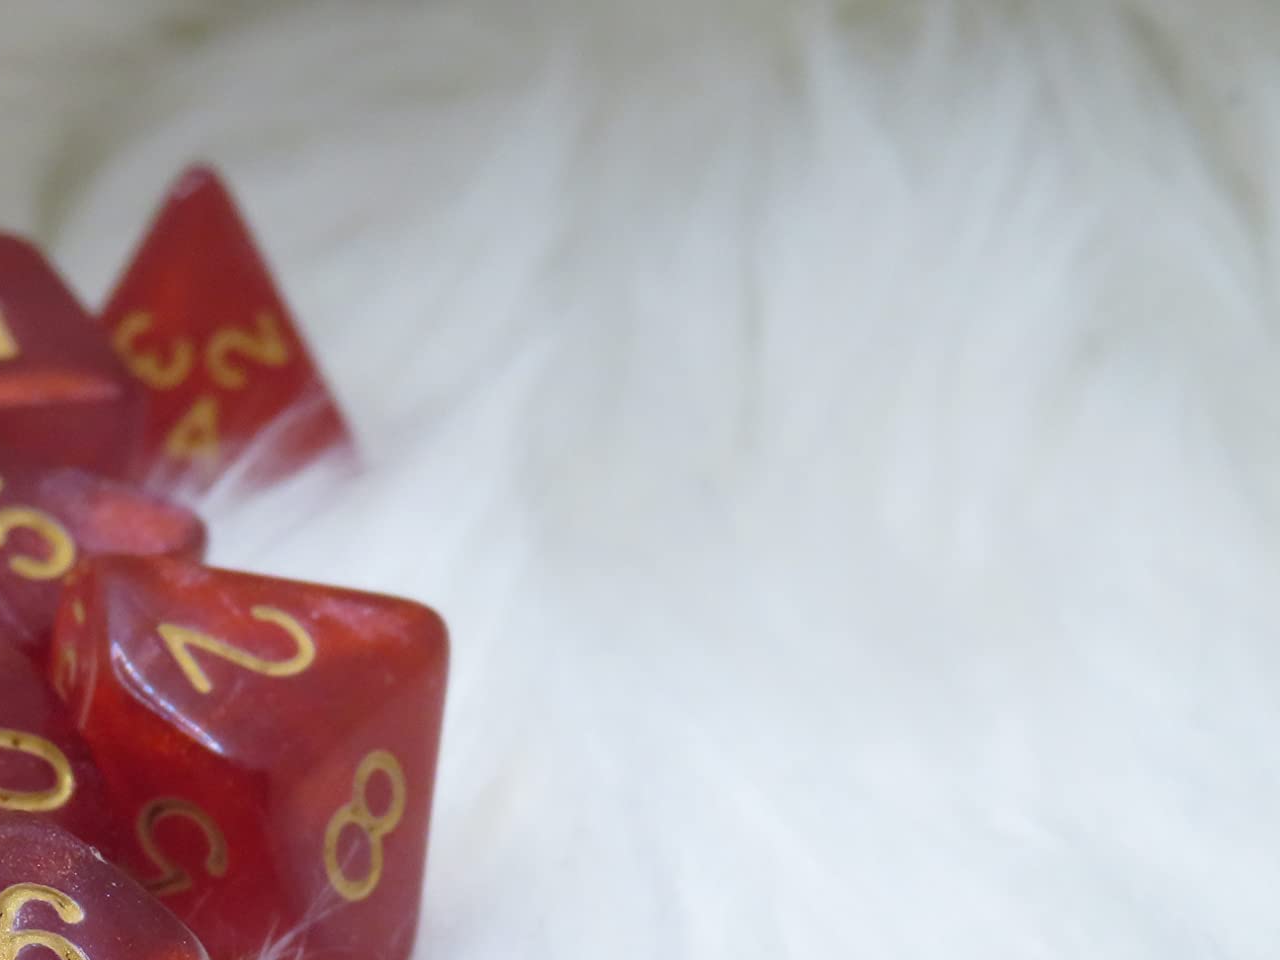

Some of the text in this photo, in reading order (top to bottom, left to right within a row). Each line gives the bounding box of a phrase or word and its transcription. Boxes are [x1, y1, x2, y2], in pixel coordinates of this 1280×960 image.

[117, 312, 193, 388] 3
[207, 310, 288, 390] 2
[158, 605, 317, 695] 2
[323, 748, 408, 903] 8
